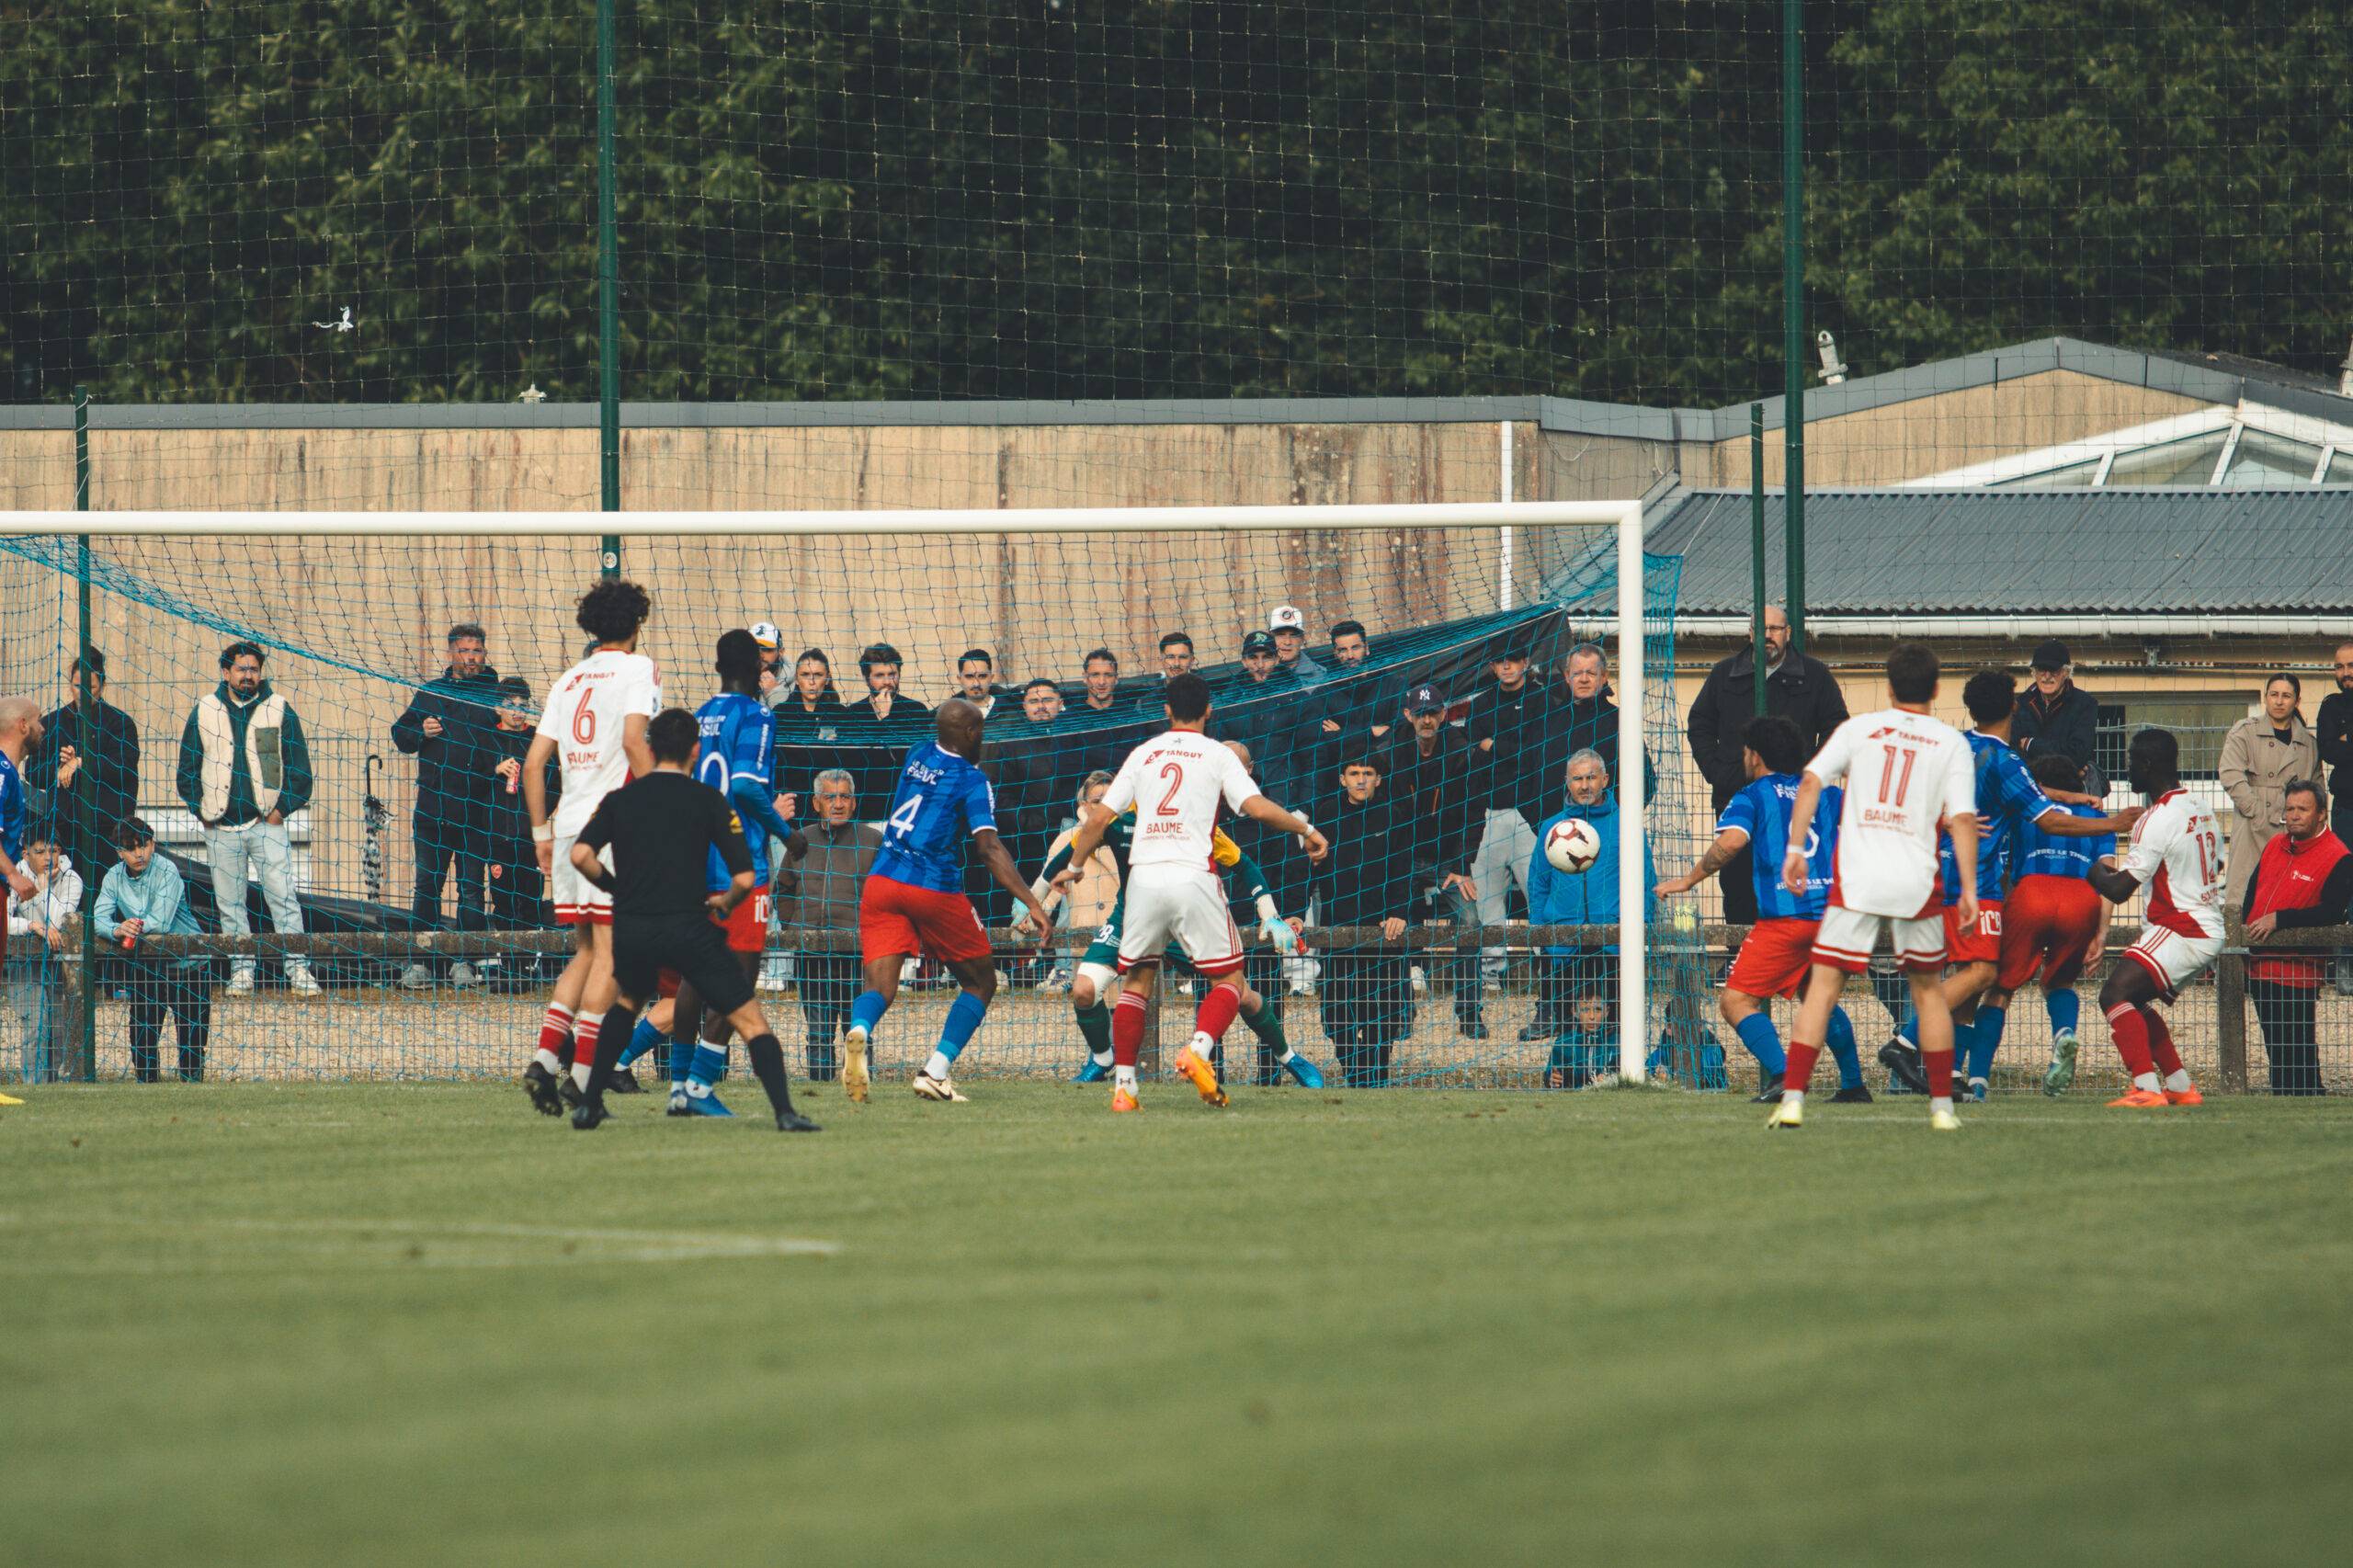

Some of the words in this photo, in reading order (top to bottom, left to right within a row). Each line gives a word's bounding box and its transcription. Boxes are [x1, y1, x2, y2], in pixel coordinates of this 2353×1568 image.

[573, 687, 596, 745] 6
[1156, 762, 1183, 816] 2
[1878, 744, 1917, 808] 11
[889, 793, 924, 839] 4
[1146, 822, 1183, 834] BAUME
